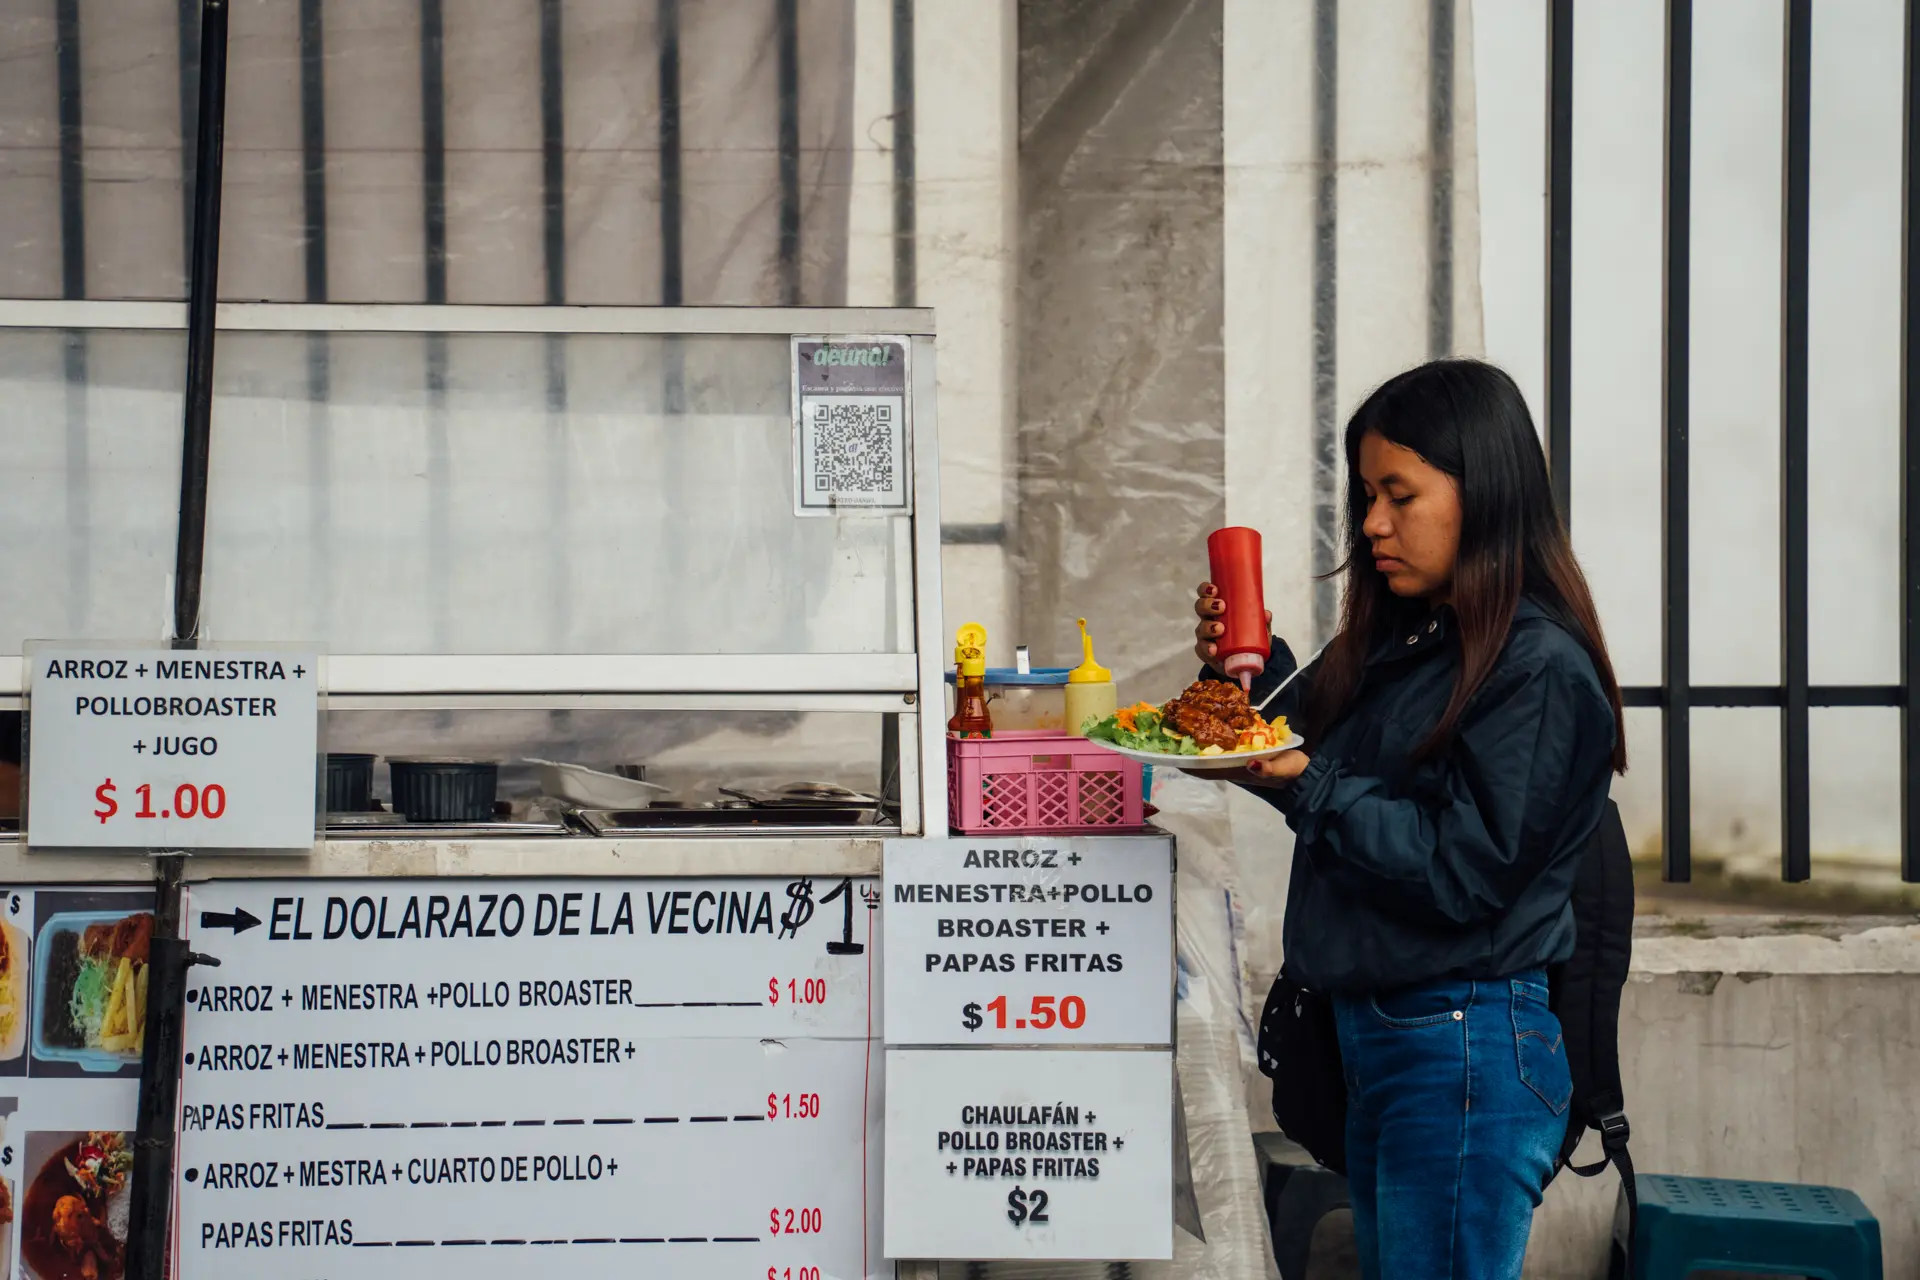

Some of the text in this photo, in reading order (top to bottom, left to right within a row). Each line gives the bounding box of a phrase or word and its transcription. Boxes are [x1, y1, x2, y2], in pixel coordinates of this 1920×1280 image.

[813, 345, 889, 367] deuna!
[46, 660, 306, 680] ARROZ + MENESTRA +
[76, 696, 277, 717] POLLOBROASTER
[133, 736, 218, 757] + JUGO
[93, 777, 227, 825] $ 1.00
[963, 849, 1082, 869] ARROZ +
[267, 890, 775, 941] EL DOLARAZO DE LA VECINA
[938, 918, 1110, 938] BROASTER +
[926, 953, 1124, 973] PAPAS FRITAS
[197, 984, 274, 1013] ARROZ
[282, 988, 293, 1008] +
[301, 982, 418, 1011] MENESTRA
[518, 978, 633, 1007] BROASTER
[788, 978, 826, 1005] 1.00
[197, 1043, 273, 1072] ARROZ
[293, 1041, 411, 1070] MENESTRA
[431, 1039, 502, 1067] POLLO
[506, 1037, 621, 1066] BROASTER
[182, 1103, 245, 1132] PAPAS
[249, 1101, 325, 1130] FRITAS
[783, 1093, 820, 1120] 1.50
[961, 1101, 1097, 1128] CHAULAFÁN +
[938, 1131, 1125, 1154] POLLO BROASTER +
[202, 1161, 279, 1190] ARROZ
[299, 1159, 388, 1187] MESTRA
[407, 1156, 496, 1185] CUARTO
[500, 1155, 528, 1183] DE
[533, 1153, 603, 1182] POLLO
[946, 1157, 1100, 1180] + PAPAS FRITAS
[1007, 1186, 1050, 1229] $2
[201, 1220, 274, 1249] PAPAS
[278, 1218, 353, 1247] FRITAS
[784, 1207, 822, 1234] 2.00
